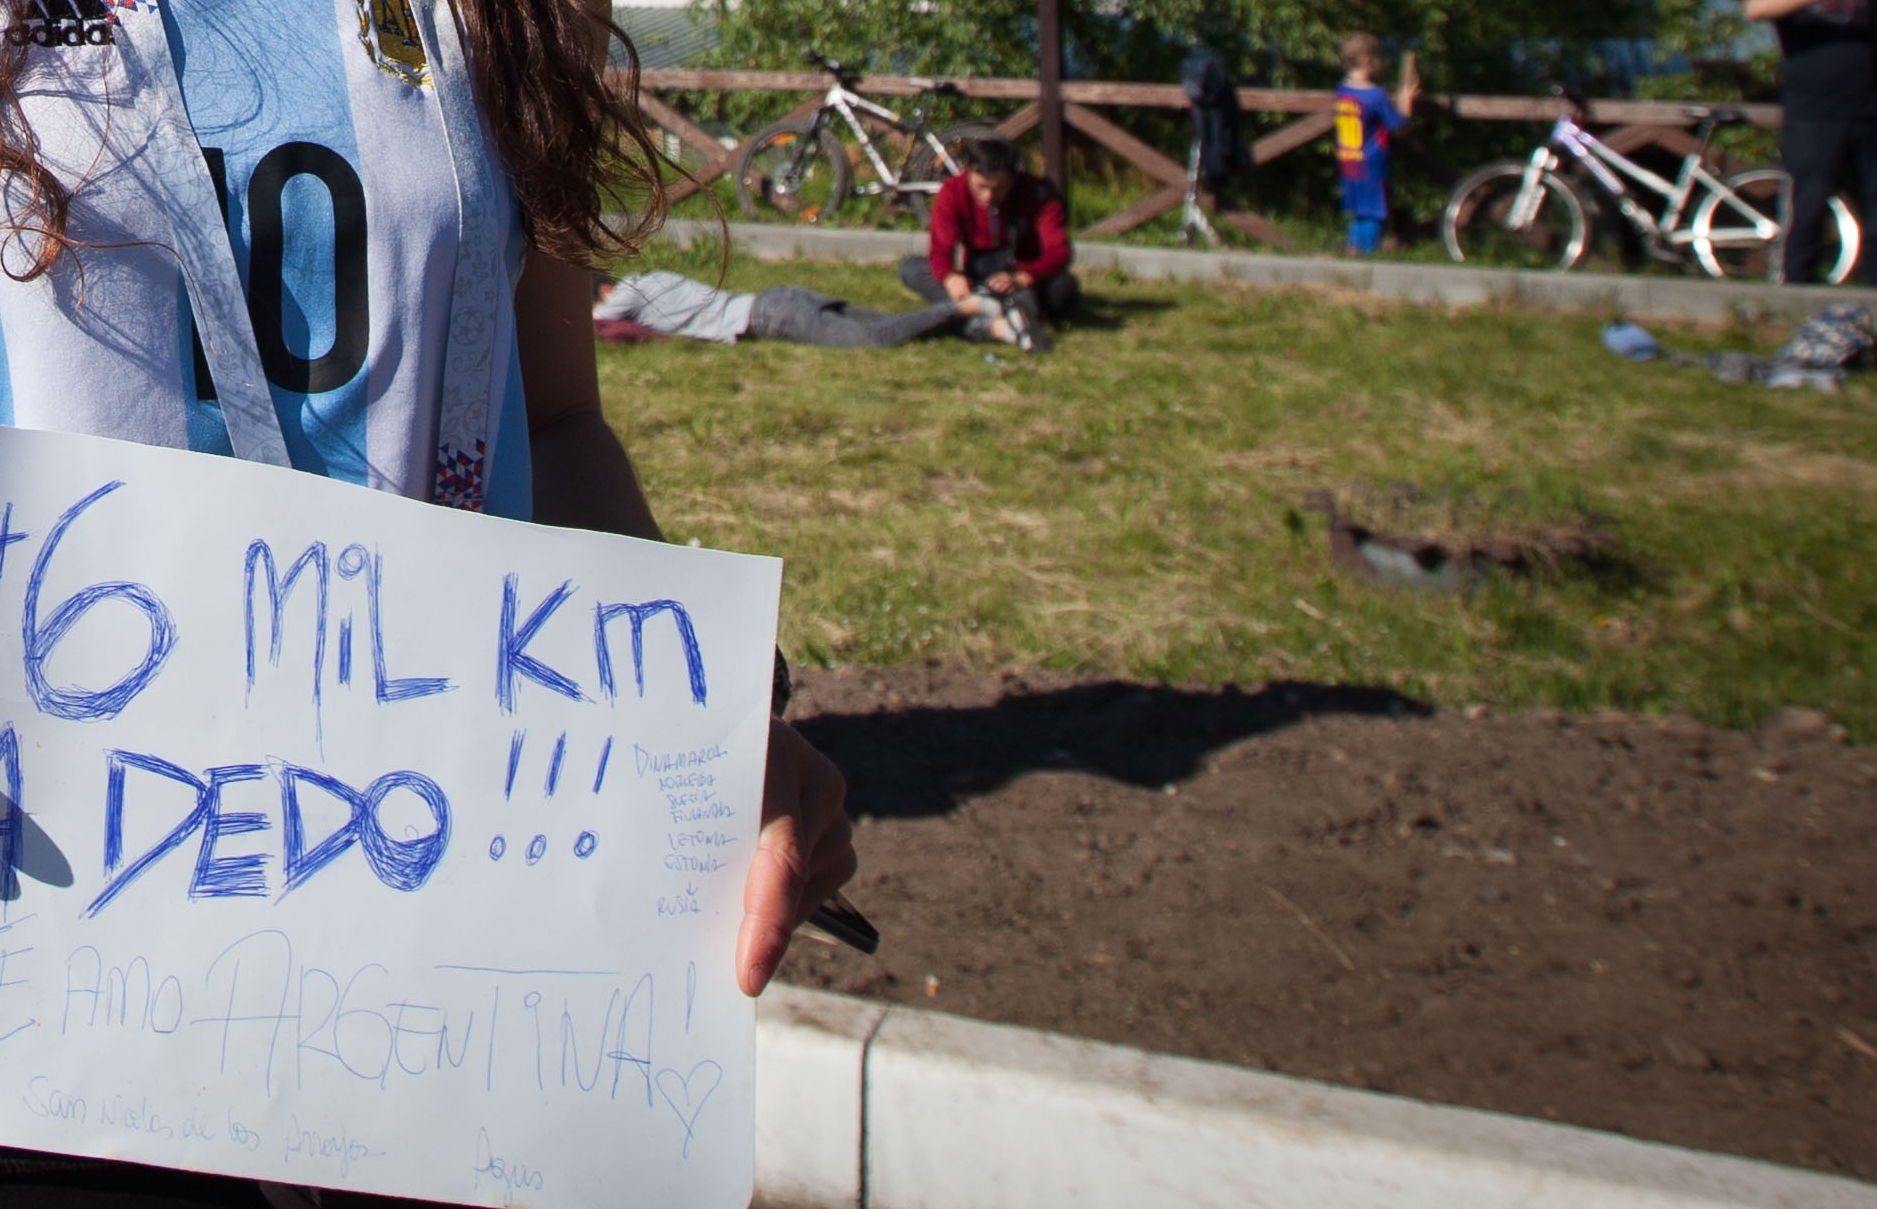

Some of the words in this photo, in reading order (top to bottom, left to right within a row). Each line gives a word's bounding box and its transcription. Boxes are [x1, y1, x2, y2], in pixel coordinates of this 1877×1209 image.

[3, 20, 117, 47] adida
[23, 1075, 87, 1124] San
[182, 1107, 213, 1142] de
